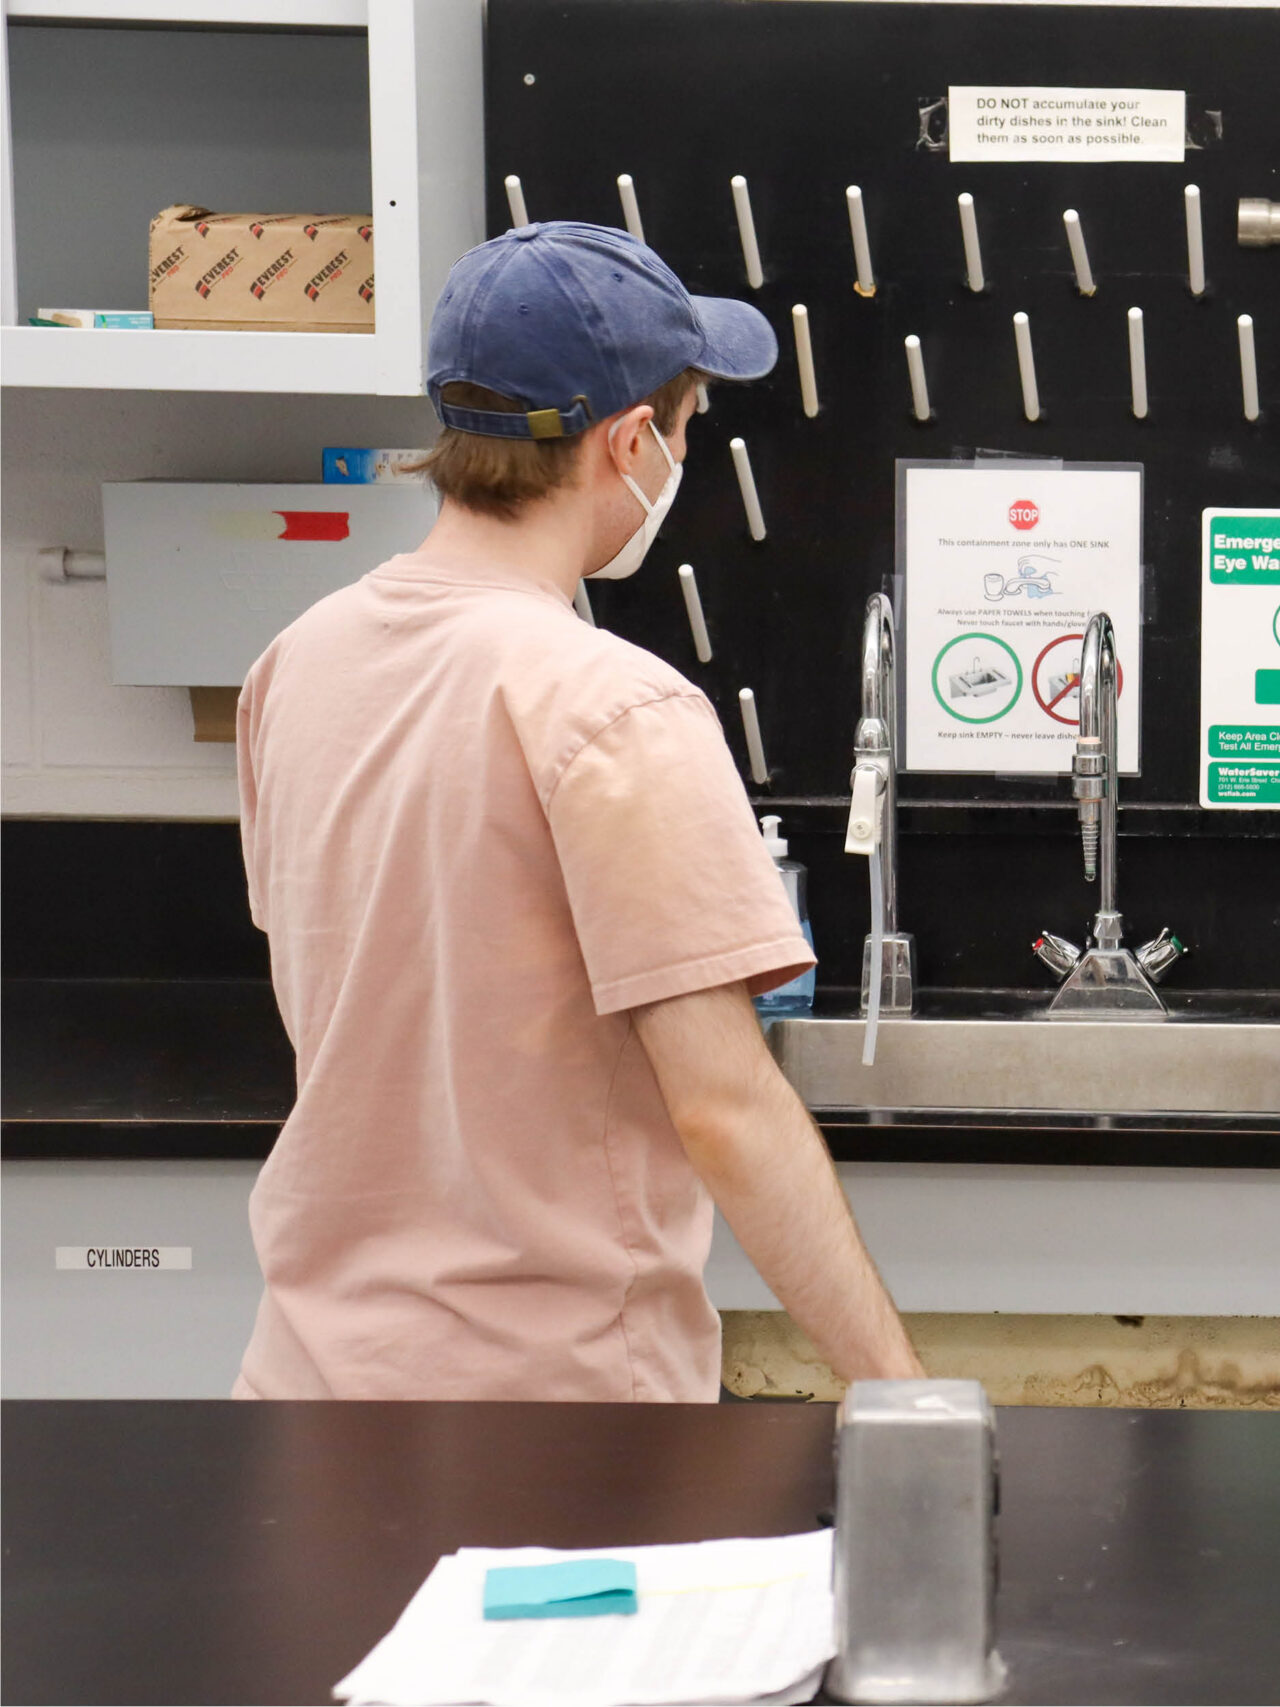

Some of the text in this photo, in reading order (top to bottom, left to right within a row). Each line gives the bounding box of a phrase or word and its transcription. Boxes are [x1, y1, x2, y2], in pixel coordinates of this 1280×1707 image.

[977, 97, 1141, 114] DO NOT accumulate your
[977, 115, 1168, 129] dirty dishes in the sink! Clean
[977, 133, 1144, 146] them as soon as possible.
[202, 247, 239, 285] EVEREST
[257, 249, 295, 286] EVEREST
[311, 250, 349, 288] EVEREST
[1009, 508, 1039, 522] STOP
[938, 537, 1110, 550] This containment zone only has ONE SINK
[1213, 554, 1247, 573] Eye
[938, 608, 963, 617] Always
[1003, 609, 1032, 617] TOWELS
[1055, 610, 1086, 619] touching
[1043, 620, 1086, 629] hands/glove
[938, 731, 957, 741] Keep
[959, 731, 974, 739] sink
[976, 732, 1003, 740] EMPTY
[1035, 732, 1056, 740] leave
[1057, 732, 1077, 740] dishe
[1218, 731, 1243, 742] Keep
[1244, 732, 1267, 741] Area
[1219, 742, 1238, 751] Test
[1240, 742, 1251, 750] All
[1218, 767, 1280, 777] WaterSaver
[87, 1248, 160, 1268] CYLINDERS
